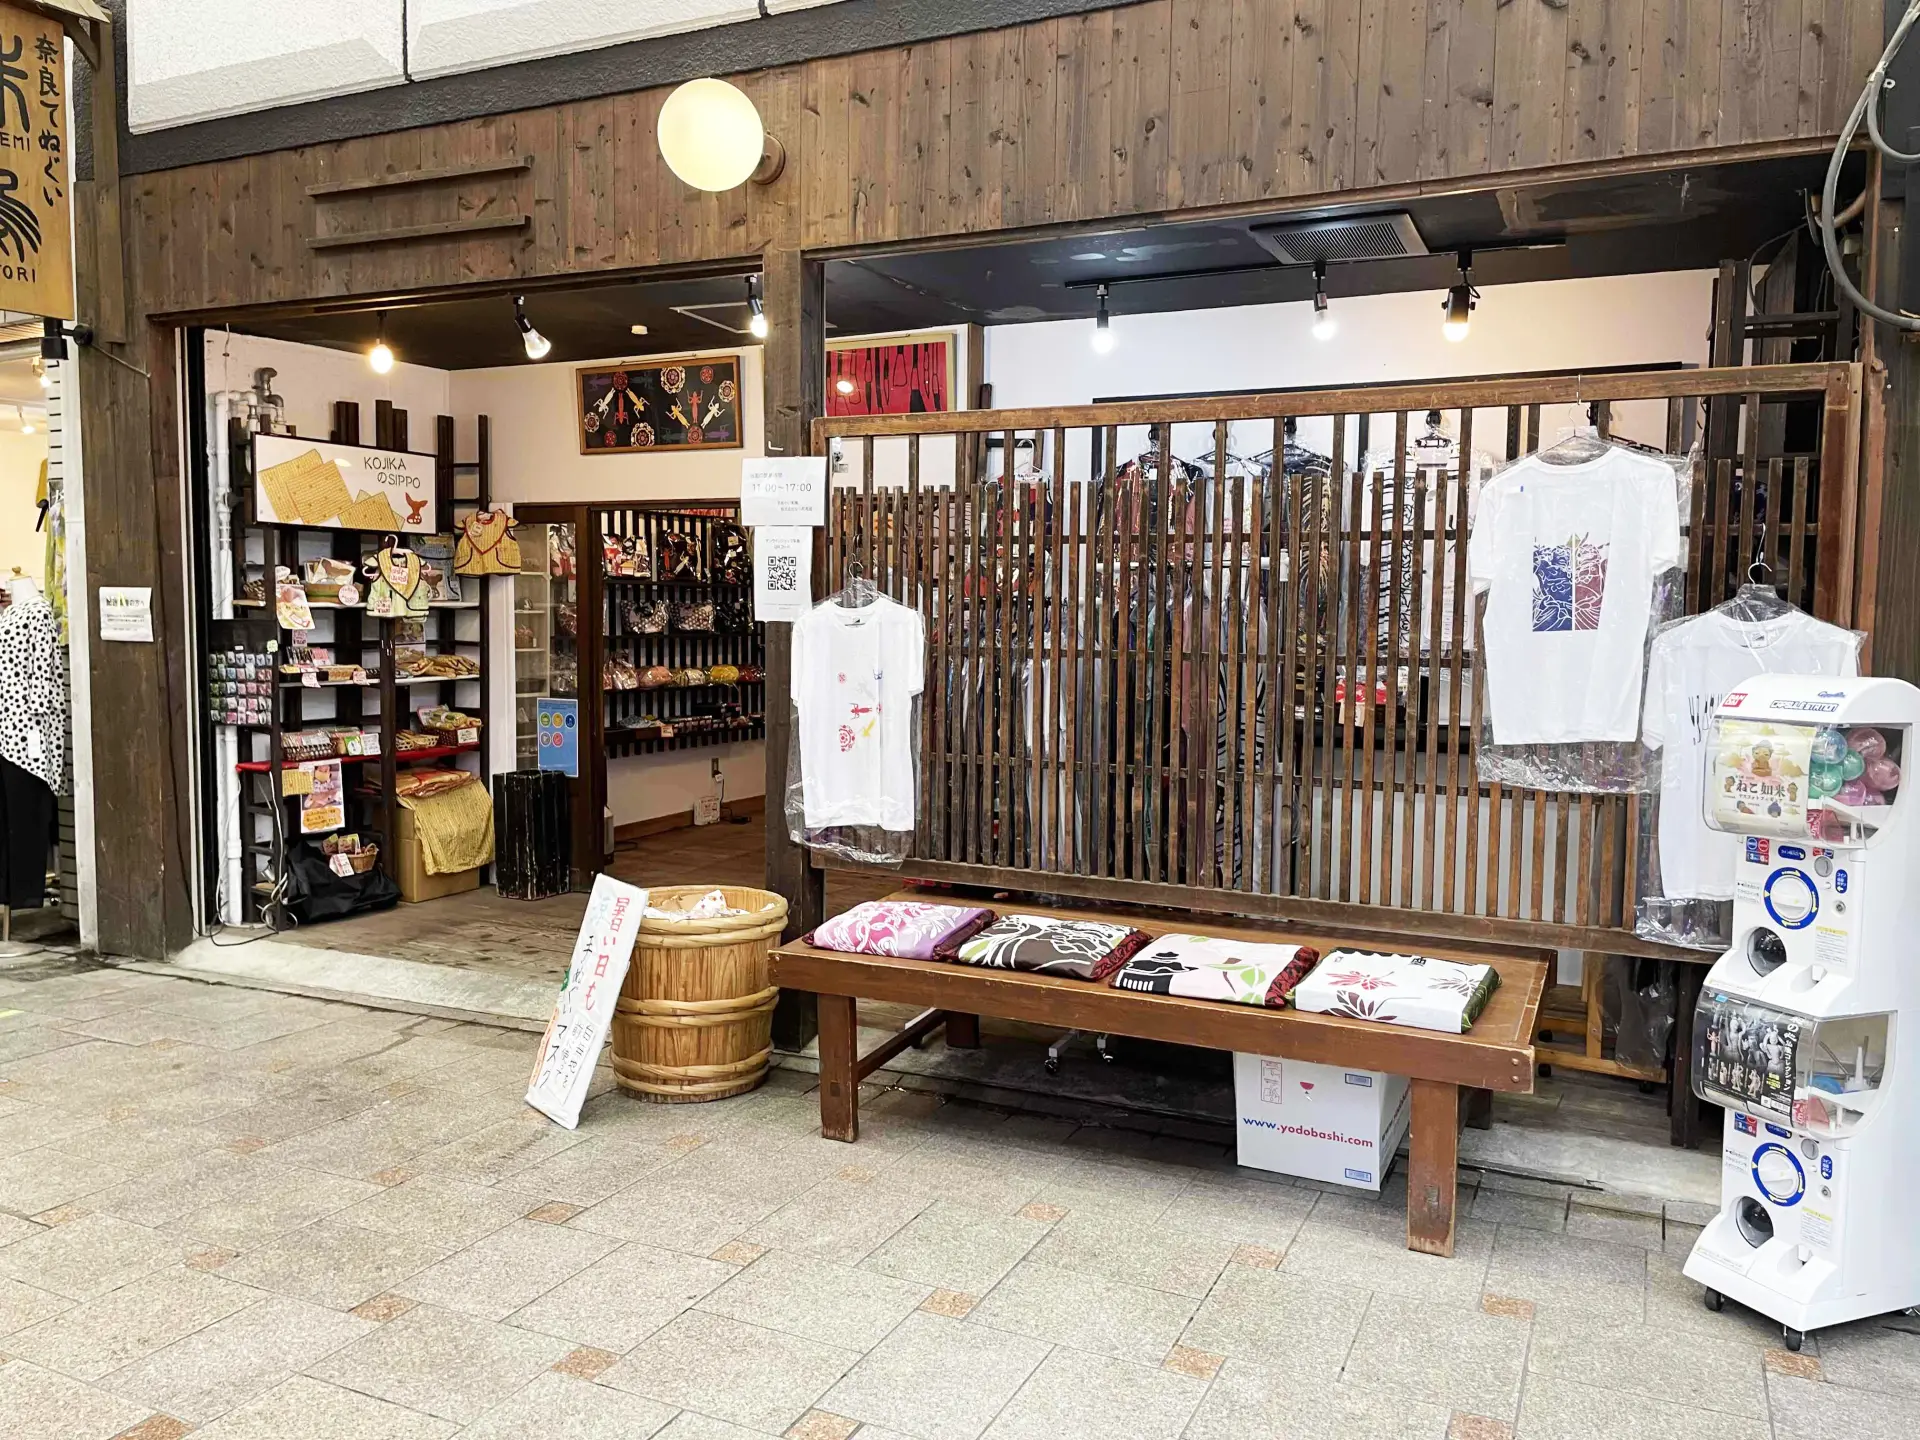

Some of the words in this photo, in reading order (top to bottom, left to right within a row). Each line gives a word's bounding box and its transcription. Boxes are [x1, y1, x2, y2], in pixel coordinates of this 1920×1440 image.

[34, 33, 63, 207] 奈良てぬぐい
[0, 131, 30, 152] EMI
[0, 264, 36, 284] ORI
[363, 456, 407, 471] KOJIKA
[376, 472, 421, 489] のSIPPO
[752, 483, 812, 493] 1100~17:00
[1736, 779, 1786, 798] ねこ如来
[1242, 1117, 1373, 1148] www.yodobashi.com
